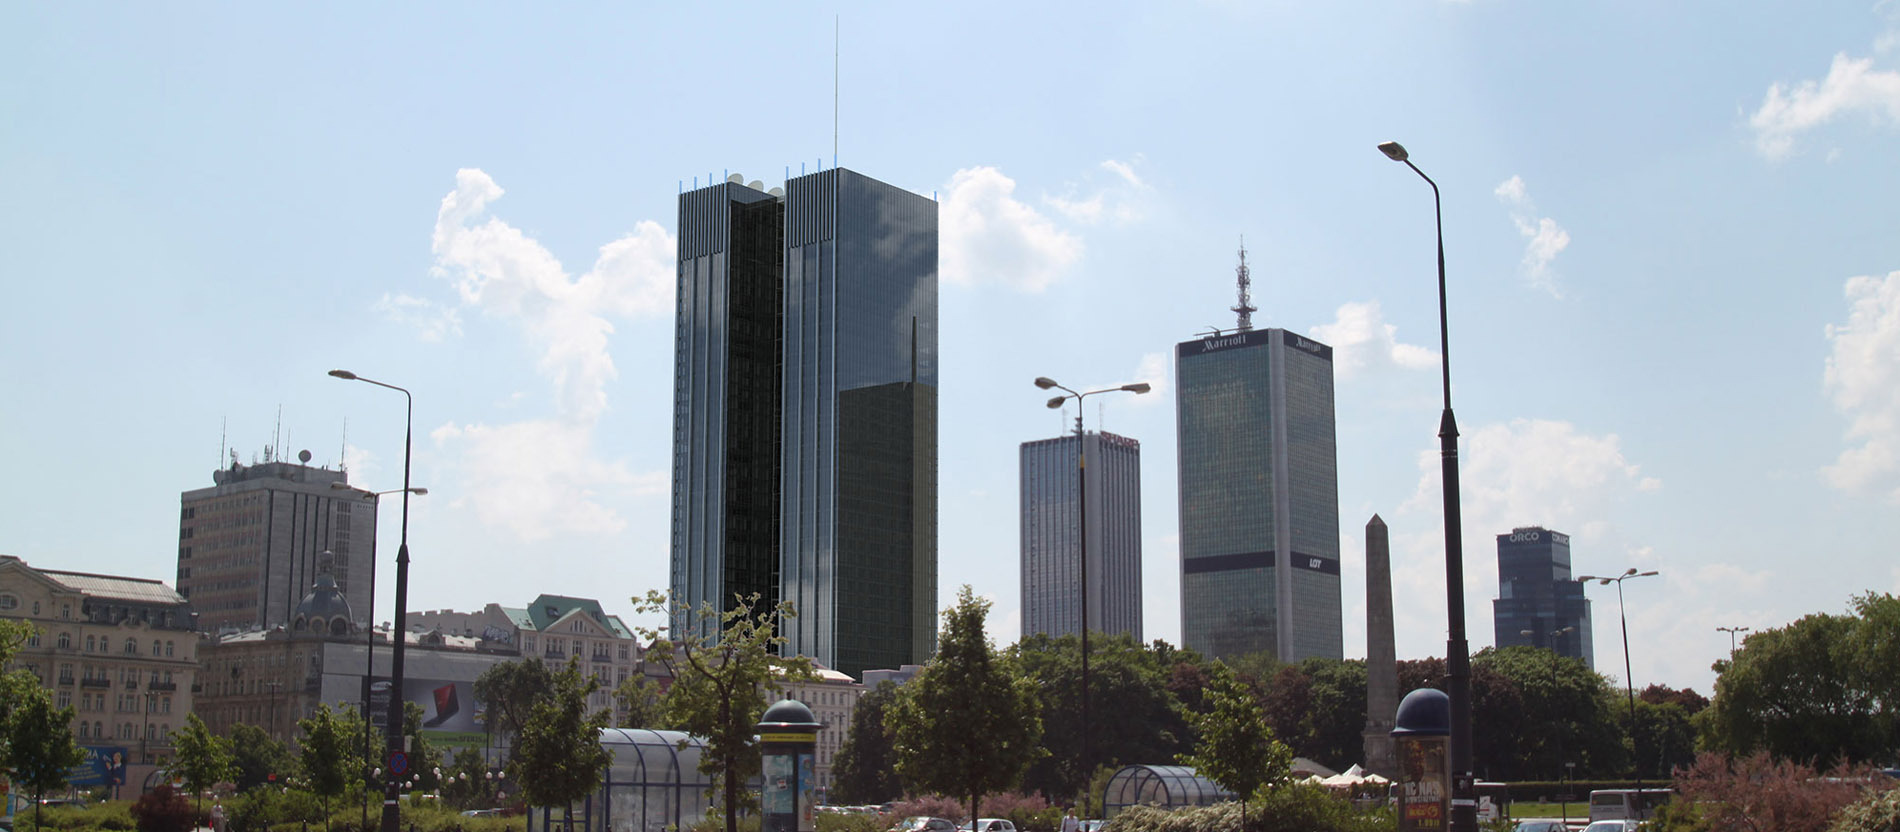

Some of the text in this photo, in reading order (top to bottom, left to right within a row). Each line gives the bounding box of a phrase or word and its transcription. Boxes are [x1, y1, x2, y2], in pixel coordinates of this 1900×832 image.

[1202, 335, 1247, 353] Marriott
[1509, 531, 1540, 544] ORCO
[1309, 558, 1322, 569] LOT
